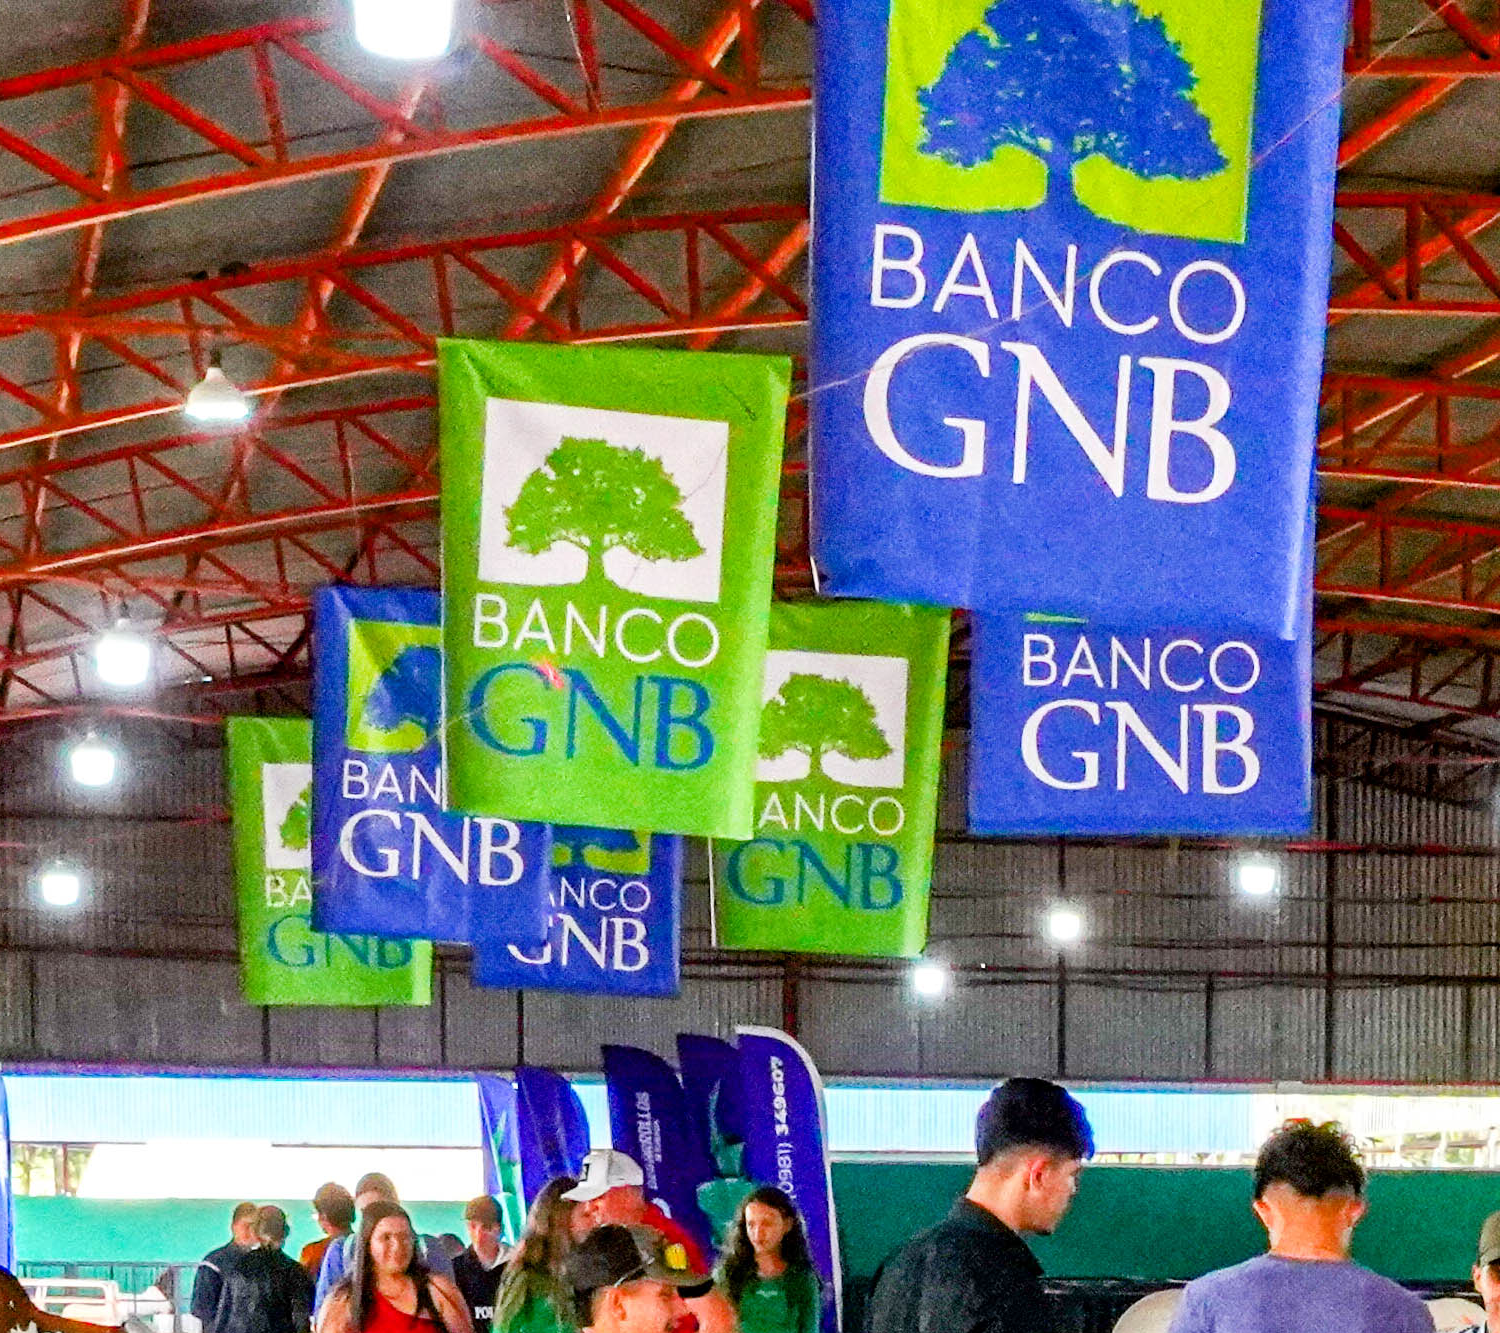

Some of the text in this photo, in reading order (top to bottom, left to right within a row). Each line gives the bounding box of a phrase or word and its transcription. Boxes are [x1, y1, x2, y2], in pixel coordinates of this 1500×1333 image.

[870, 224, 1247, 345] BANCO
[862, 333, 1237, 504] GNB
[472, 593, 720, 668] BANCO
[1021, 634, 1262, 695] BANCO
[468, 662, 715, 771] GNB
[1020, 698, 1262, 796] GNB
[342, 759, 441, 805] BAN
[758, 792, 905, 836] ANCO
[339, 809, 524, 886] GNB
[727, 838, 904, 910] GNB
[549, 877, 651, 913] NCO
